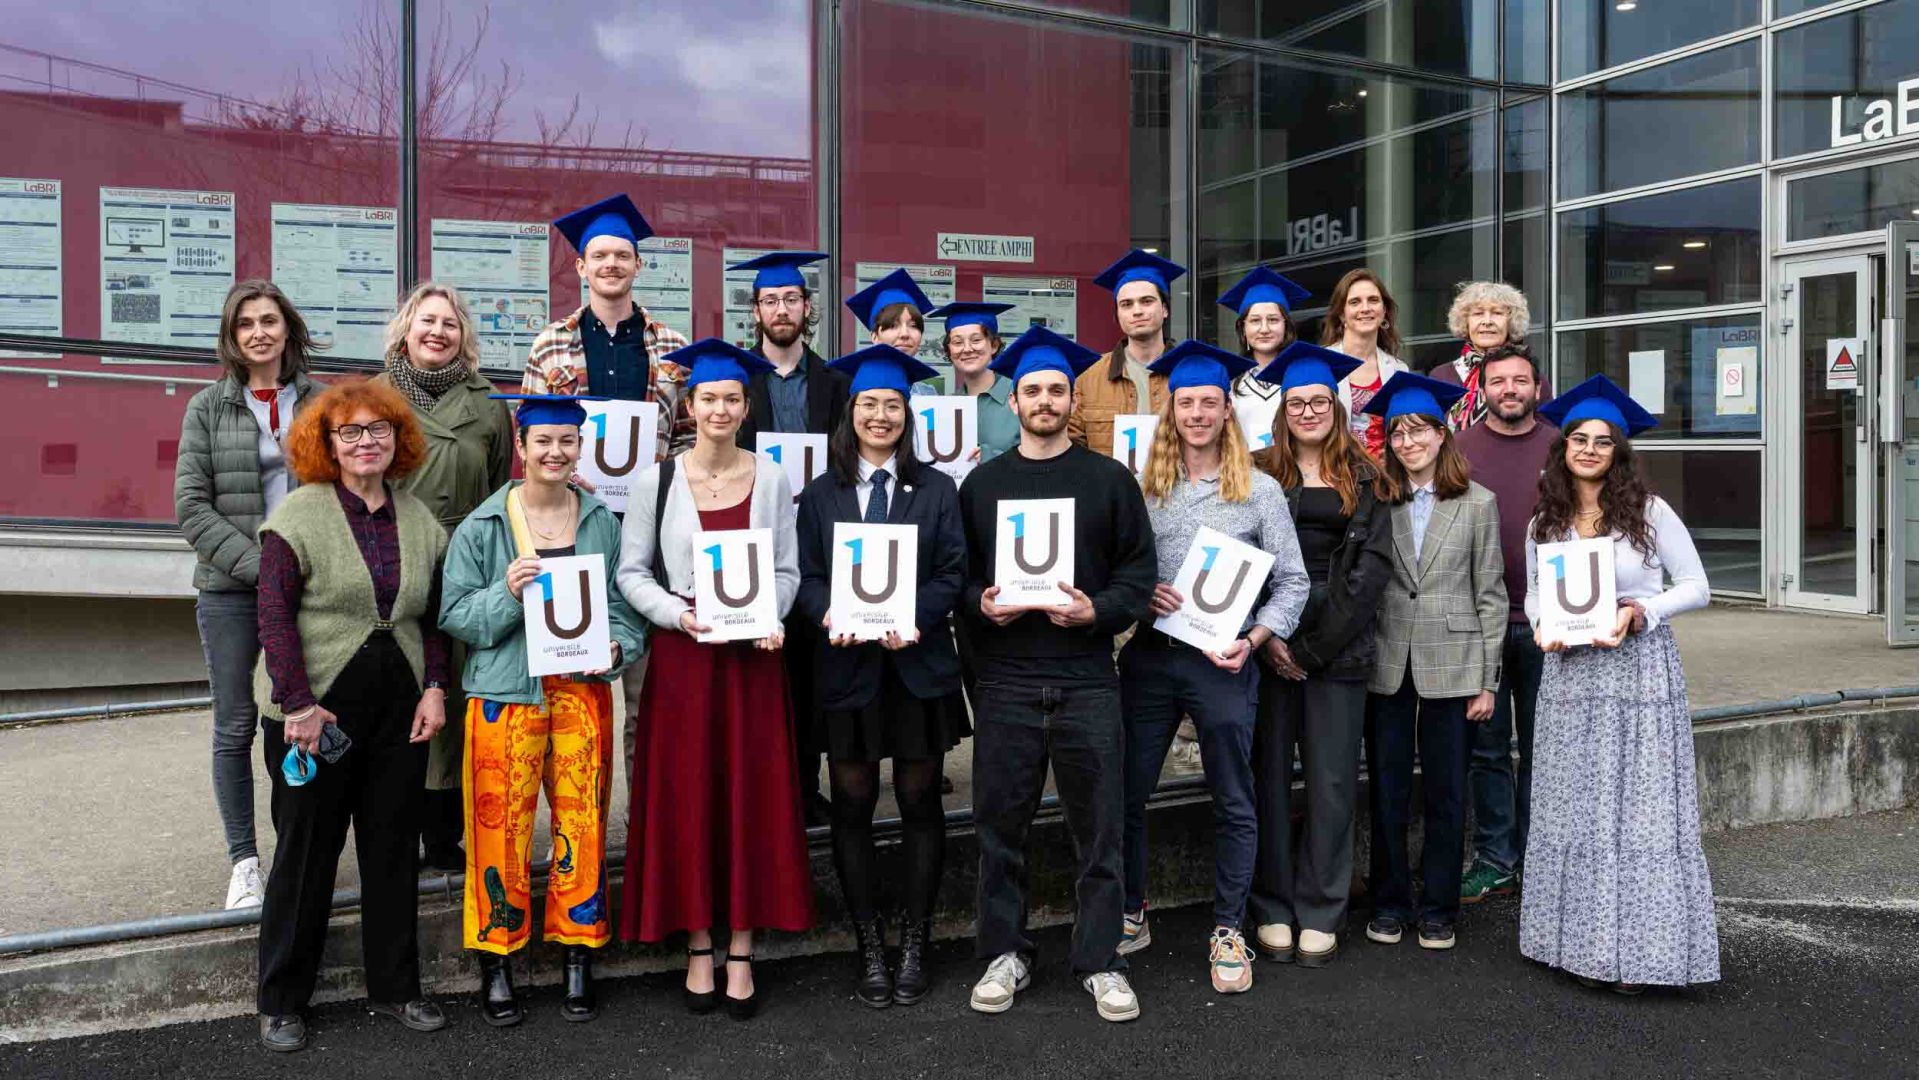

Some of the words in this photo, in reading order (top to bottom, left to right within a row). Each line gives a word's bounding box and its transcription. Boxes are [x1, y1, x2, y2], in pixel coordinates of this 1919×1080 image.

[24, 182, 56, 193] LaBRI
[196, 194, 232, 206] LaBRI
[365, 211, 393, 221] LaBRI
[519, 225, 546, 235] LaBRI
[663, 239, 689, 249] LaBRI
[956, 238, 997, 256] ENTREE
[998, 240, 1033, 258] AMPHI
[929, 268, 953, 278] LaBRI
[1049, 279, 1075, 290] LaBRI
[556, 649, 589, 658] BORDEAUX
